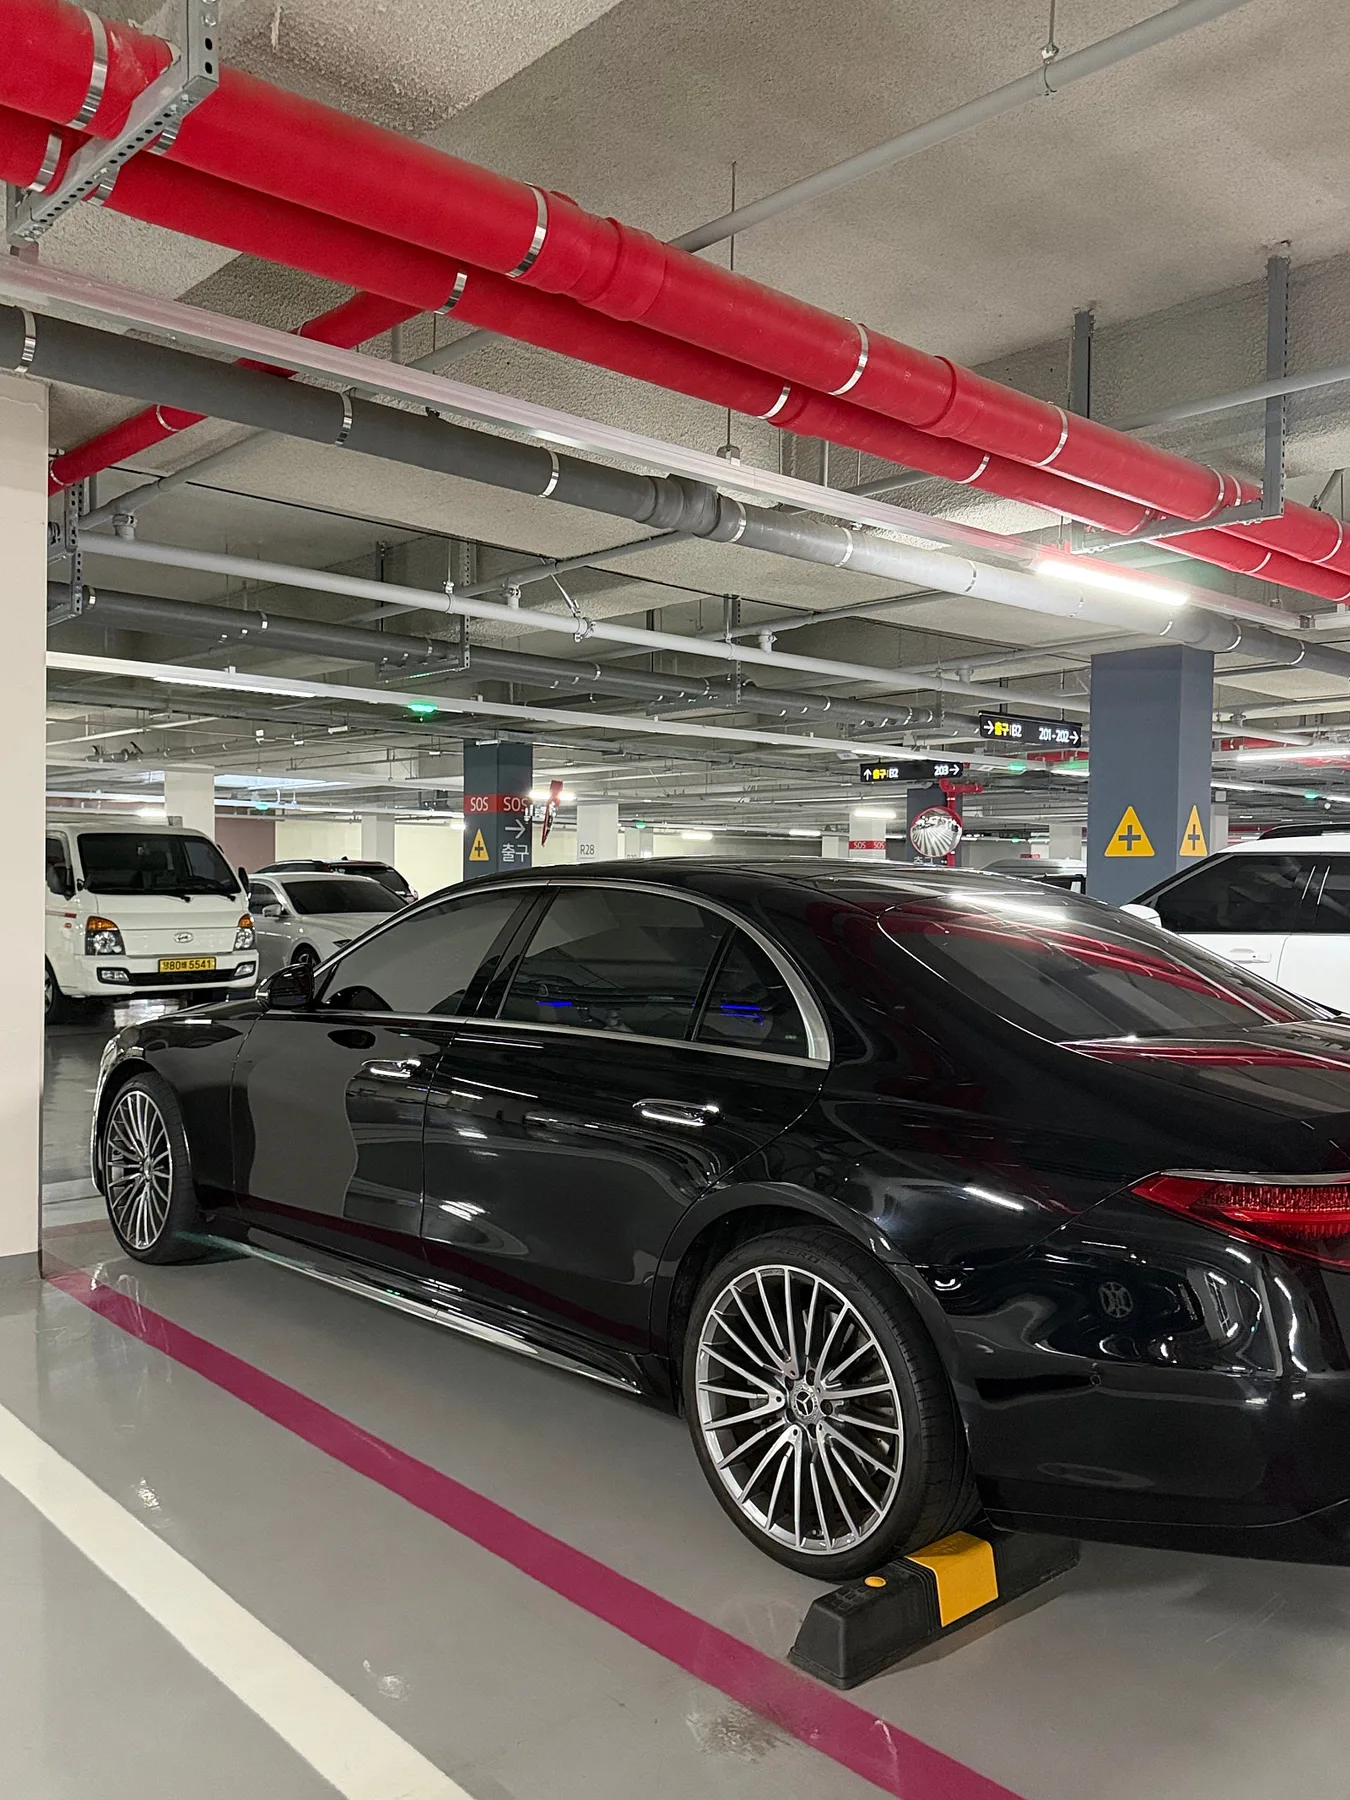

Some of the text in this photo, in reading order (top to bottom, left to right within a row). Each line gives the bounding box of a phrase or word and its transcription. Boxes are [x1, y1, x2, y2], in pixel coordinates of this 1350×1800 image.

[933, 765, 949, 776] 203
[470, 796, 489, 812] SOS
[503, 796, 528, 812] SOS
[580, 844, 595, 855] R28
[853, 841, 867, 849] SOS
[873, 841, 885, 849] SOS
[501, 842, 530, 863] 출구
[188, 959, 211, 970] 5541
